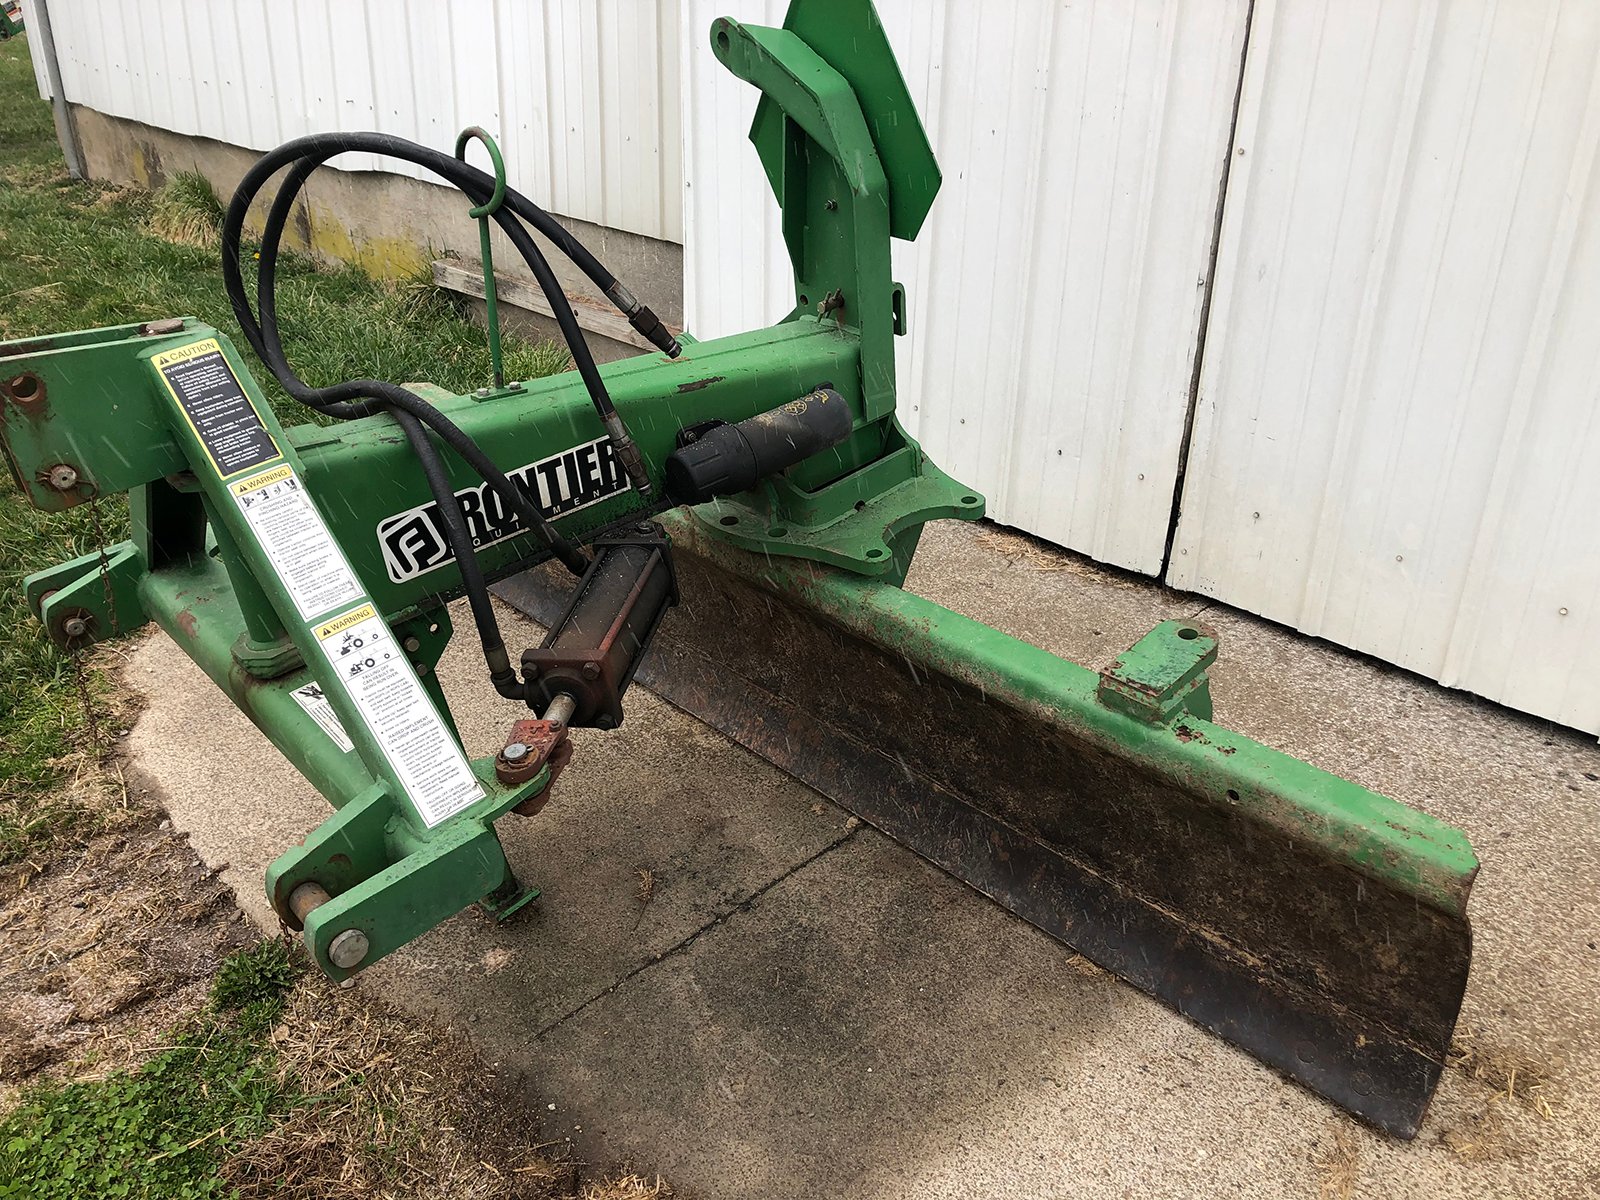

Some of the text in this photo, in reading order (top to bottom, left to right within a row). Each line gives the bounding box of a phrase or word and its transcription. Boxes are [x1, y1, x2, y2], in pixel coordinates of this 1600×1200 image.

[168, 341, 215, 361] CAUTION
[247, 469, 287, 488] WARNING
[450, 481, 618, 557] QUIMENT
[330, 609, 370, 632] WARNING
